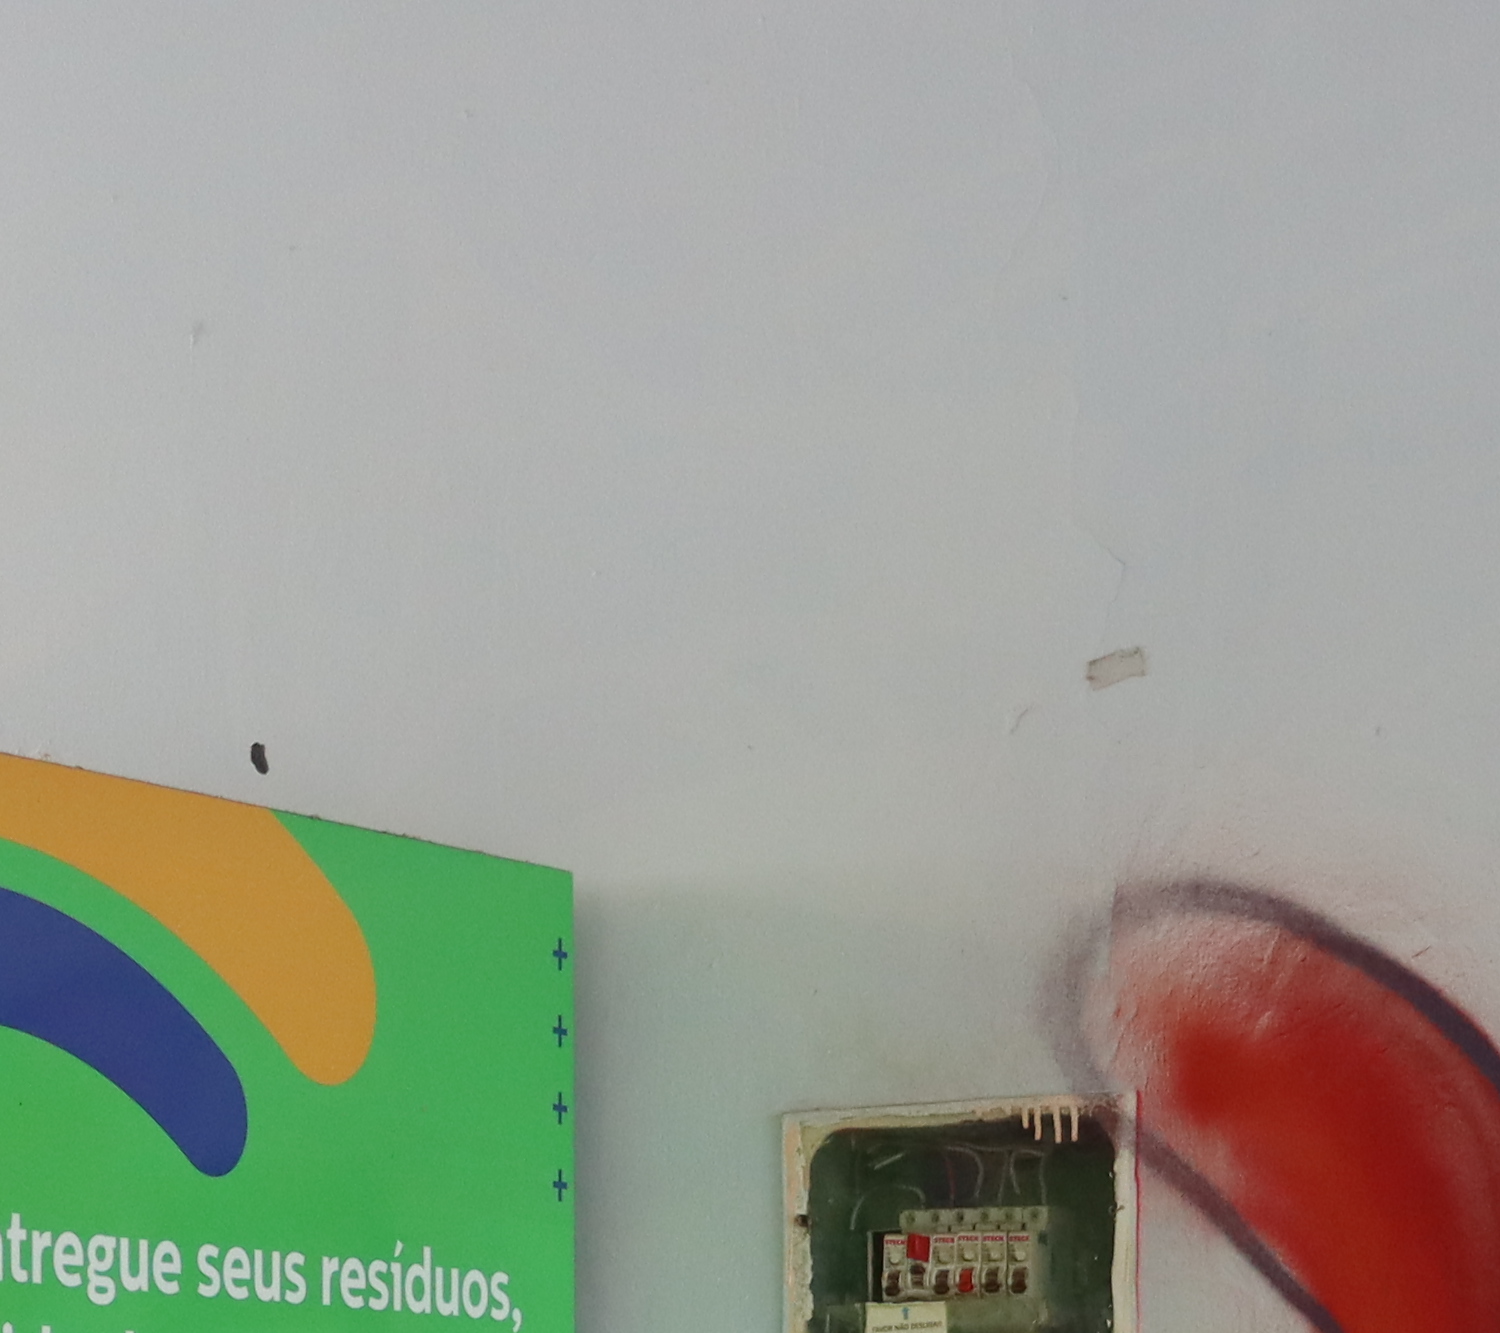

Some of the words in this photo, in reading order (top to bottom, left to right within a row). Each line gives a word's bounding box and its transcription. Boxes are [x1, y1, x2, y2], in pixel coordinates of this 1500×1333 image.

[196, 1243, 307, 1305] seus
[321, 1240, 523, 1333] resíduos,
[871, 1325, 893, 1333] FAVOR
[894, 1322, 909, 1331] NÃO
